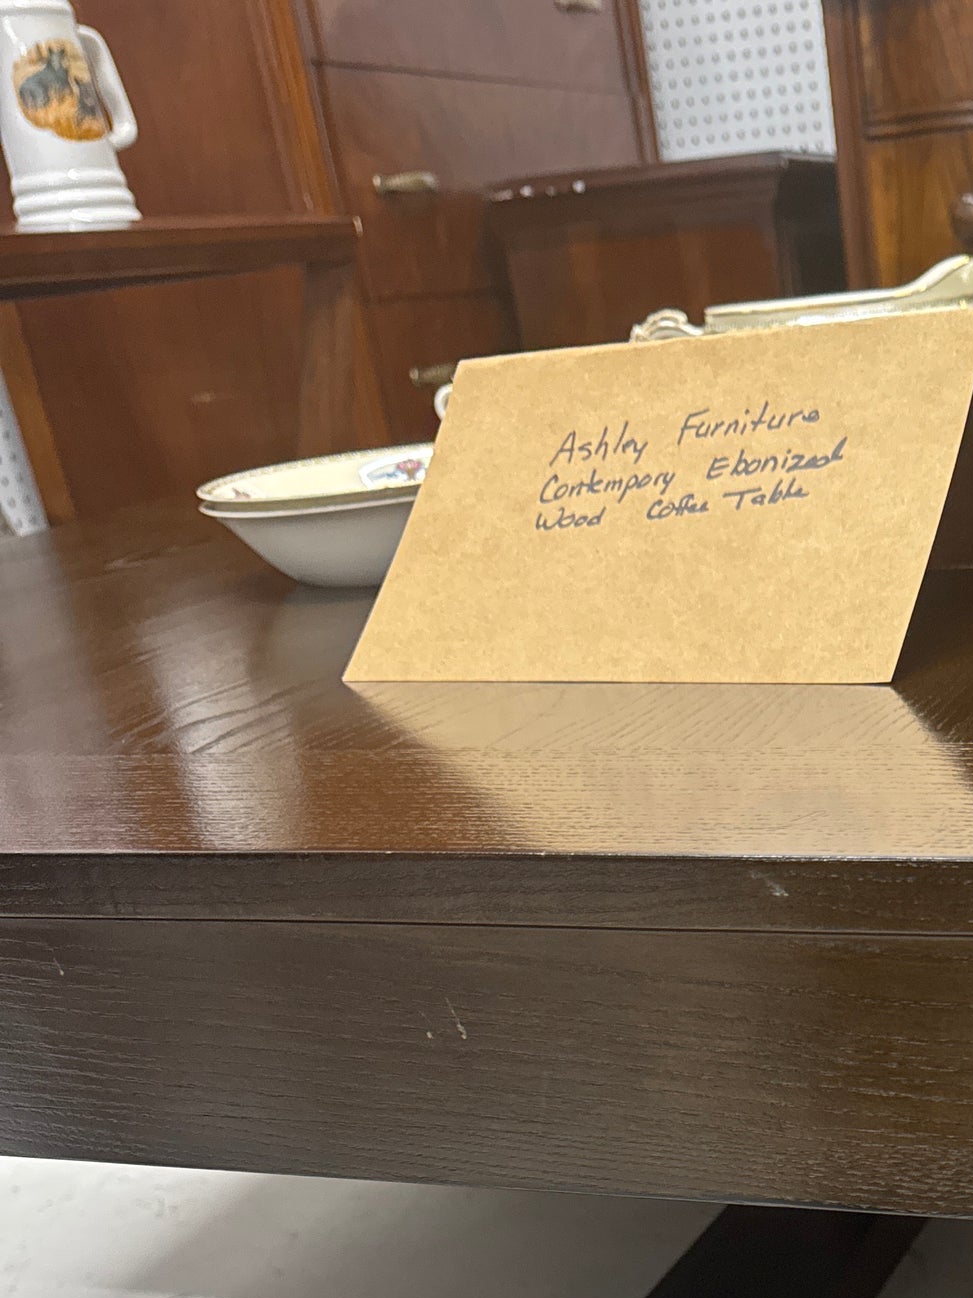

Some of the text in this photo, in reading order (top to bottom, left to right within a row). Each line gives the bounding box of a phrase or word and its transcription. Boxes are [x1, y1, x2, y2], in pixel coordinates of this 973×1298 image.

[549, 400, 820, 467] Ashley Furniture
[705, 436, 848, 481] Ebonized
[535, 477, 810, 531] Wood Coffee Table
